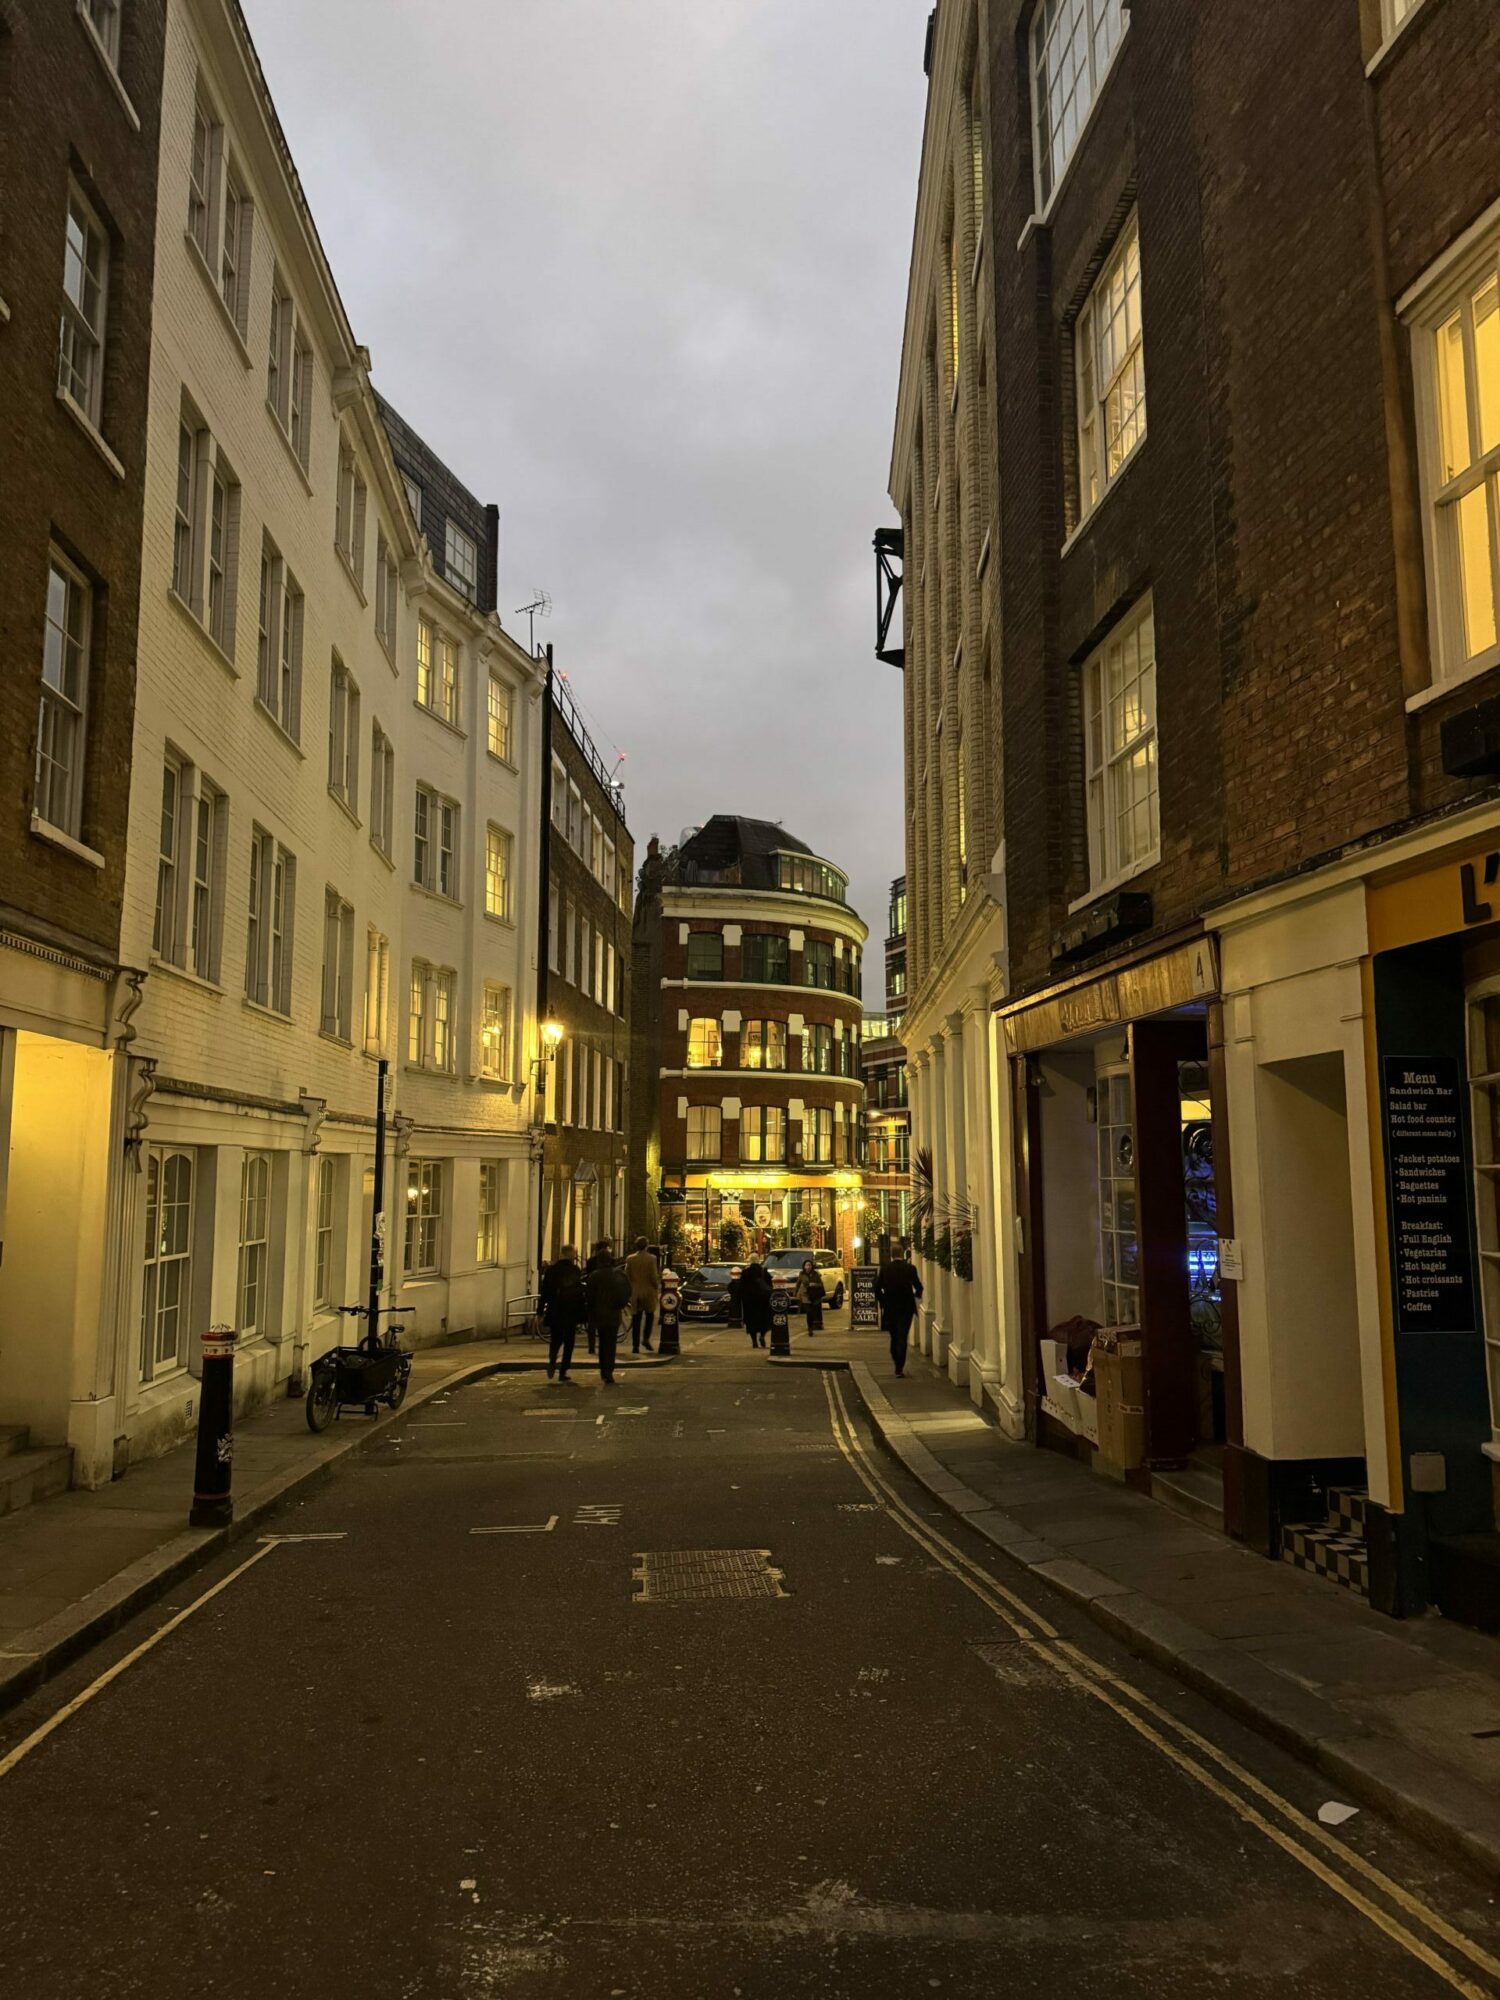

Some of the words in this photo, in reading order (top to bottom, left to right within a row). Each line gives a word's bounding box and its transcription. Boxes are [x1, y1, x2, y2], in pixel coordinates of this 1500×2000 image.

[1403, 1072, 1437, 1084] Menu
[1389, 1087, 1434, 1095] Sandwich
[1436, 1087, 1453, 1095] Bar
[1390, 1102, 1411, 1110] Salad
[1413, 1102, 1427, 1110] bar
[1390, 1115, 1406, 1123] Hot
[1407, 1115, 1424, 1123] food
[1398, 1155, 1426, 1163] Jacket
[1427, 1155, 1460, 1164] potatoes
[1399, 1168, 1446, 1176] Sandwiches
[1400, 1181, 1439, 1191] Baguettes
[1400, 1194, 1415, 1203] Hot
[1417, 1194, 1447, 1204] paninis
[1402, 1221, 1443, 1230] Breakfast:
[1403, 1235, 1420, 1243] Full
[1421, 1234, 1452, 1245] English
[1404, 1248, 1447, 1259] Vegetarian
[1404, 1262, 1420, 1271] Hot
[1421, 1261, 1447, 1272] bagels
[1405, 1276, 1420, 1284] Hot
[1422, 1275, 1463, 1284] croissants
[1406, 1289, 1439, 1298] Pastries
[1407, 1302, 1432, 1311] Coffee
